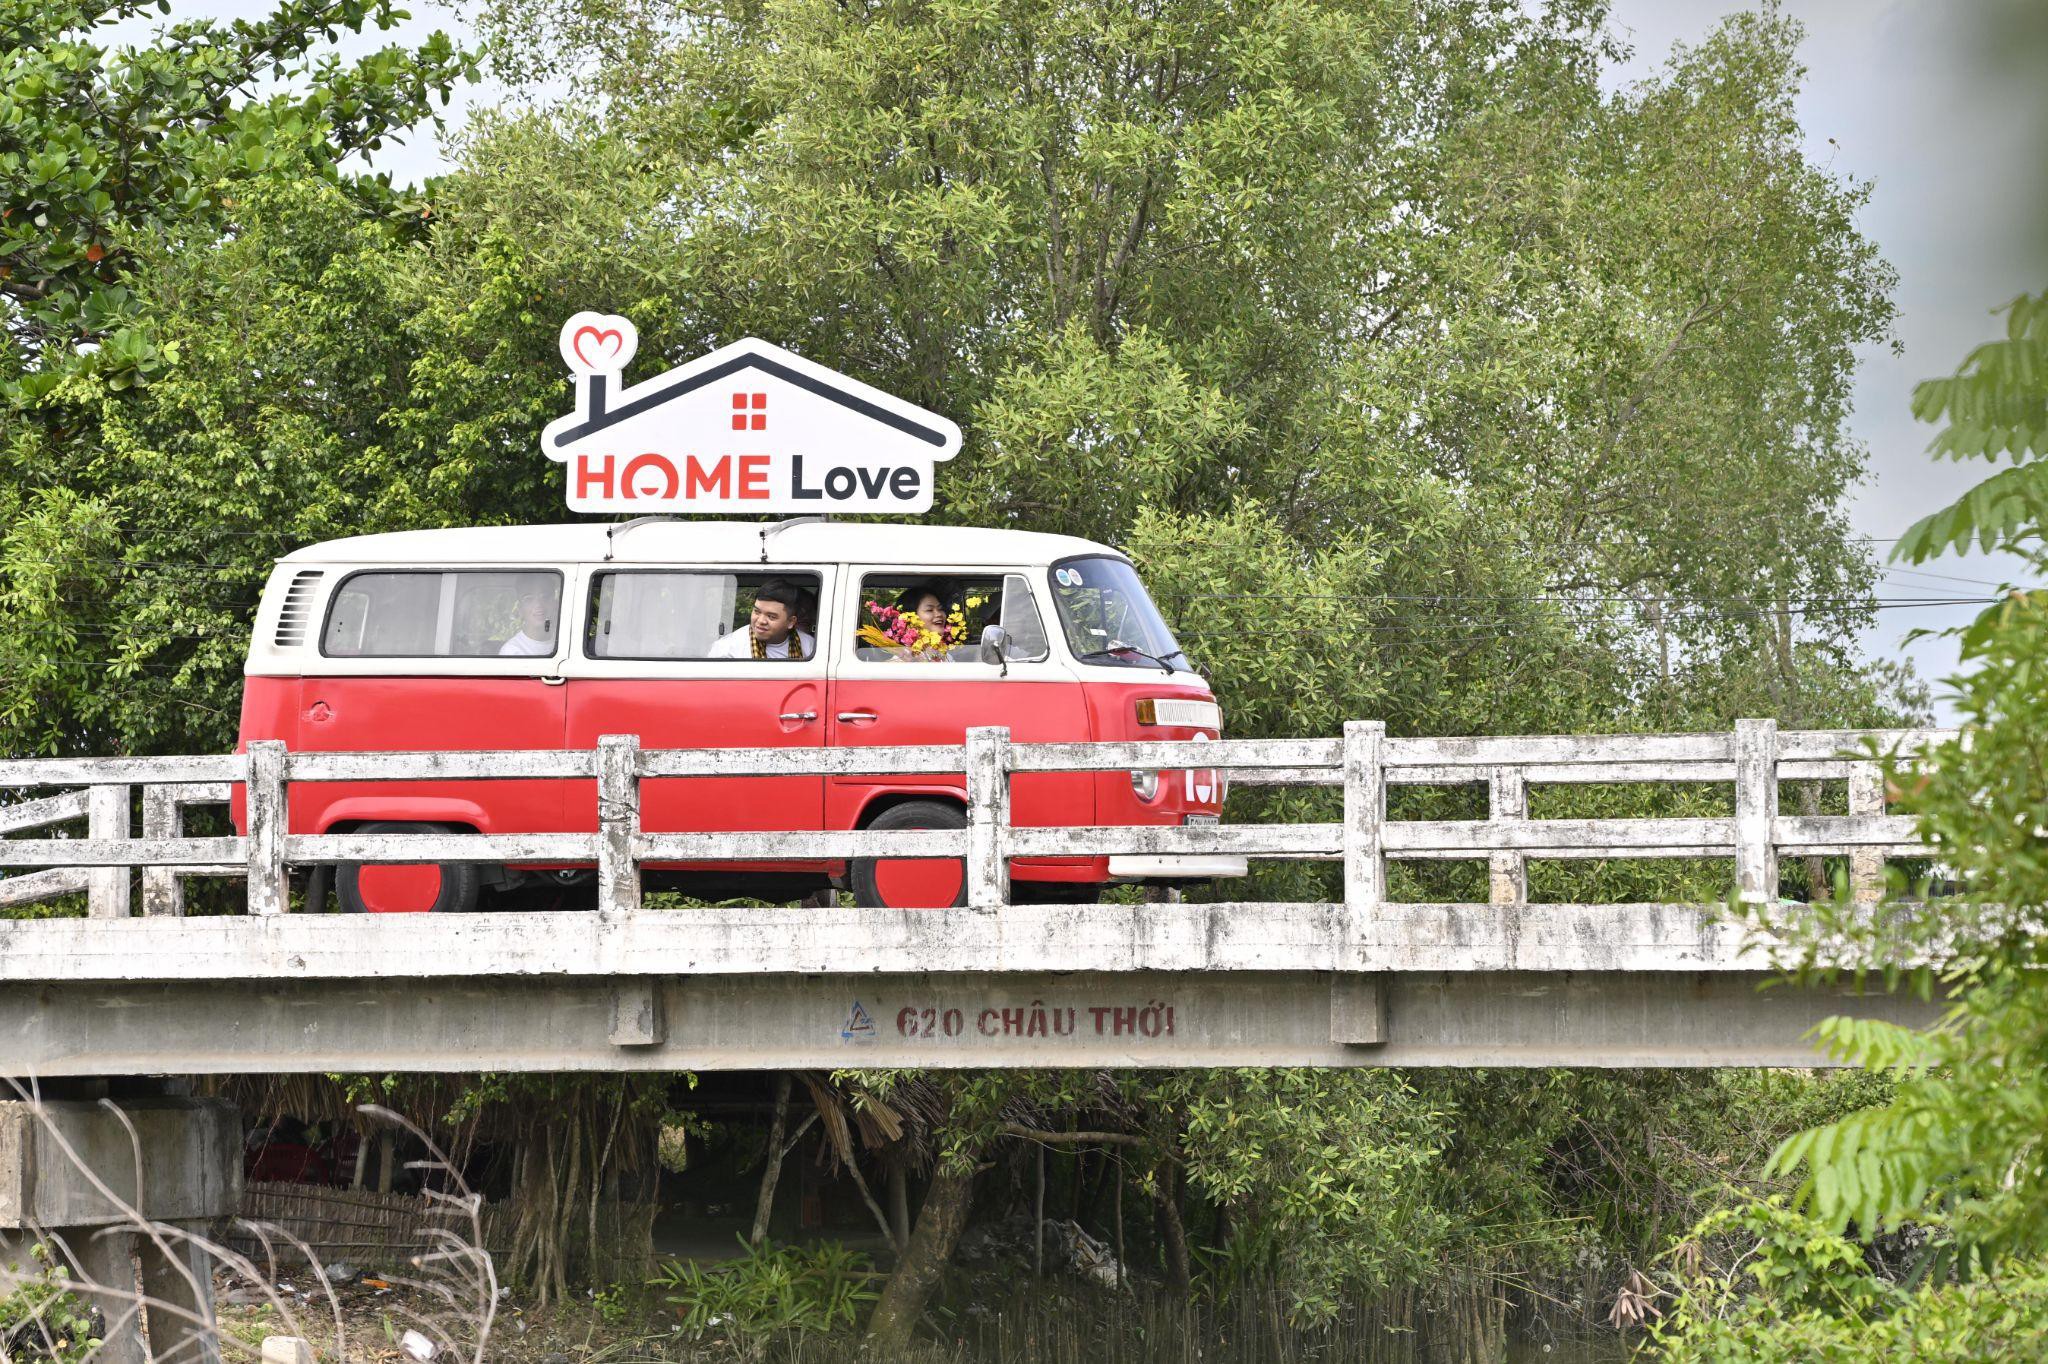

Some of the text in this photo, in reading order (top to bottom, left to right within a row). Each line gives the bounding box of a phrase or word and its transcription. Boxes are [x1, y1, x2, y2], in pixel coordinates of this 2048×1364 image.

[577, 453, 921, 501] HOME Love
[896, 999, 1174, 1038] 620 CHÂU THỚI
